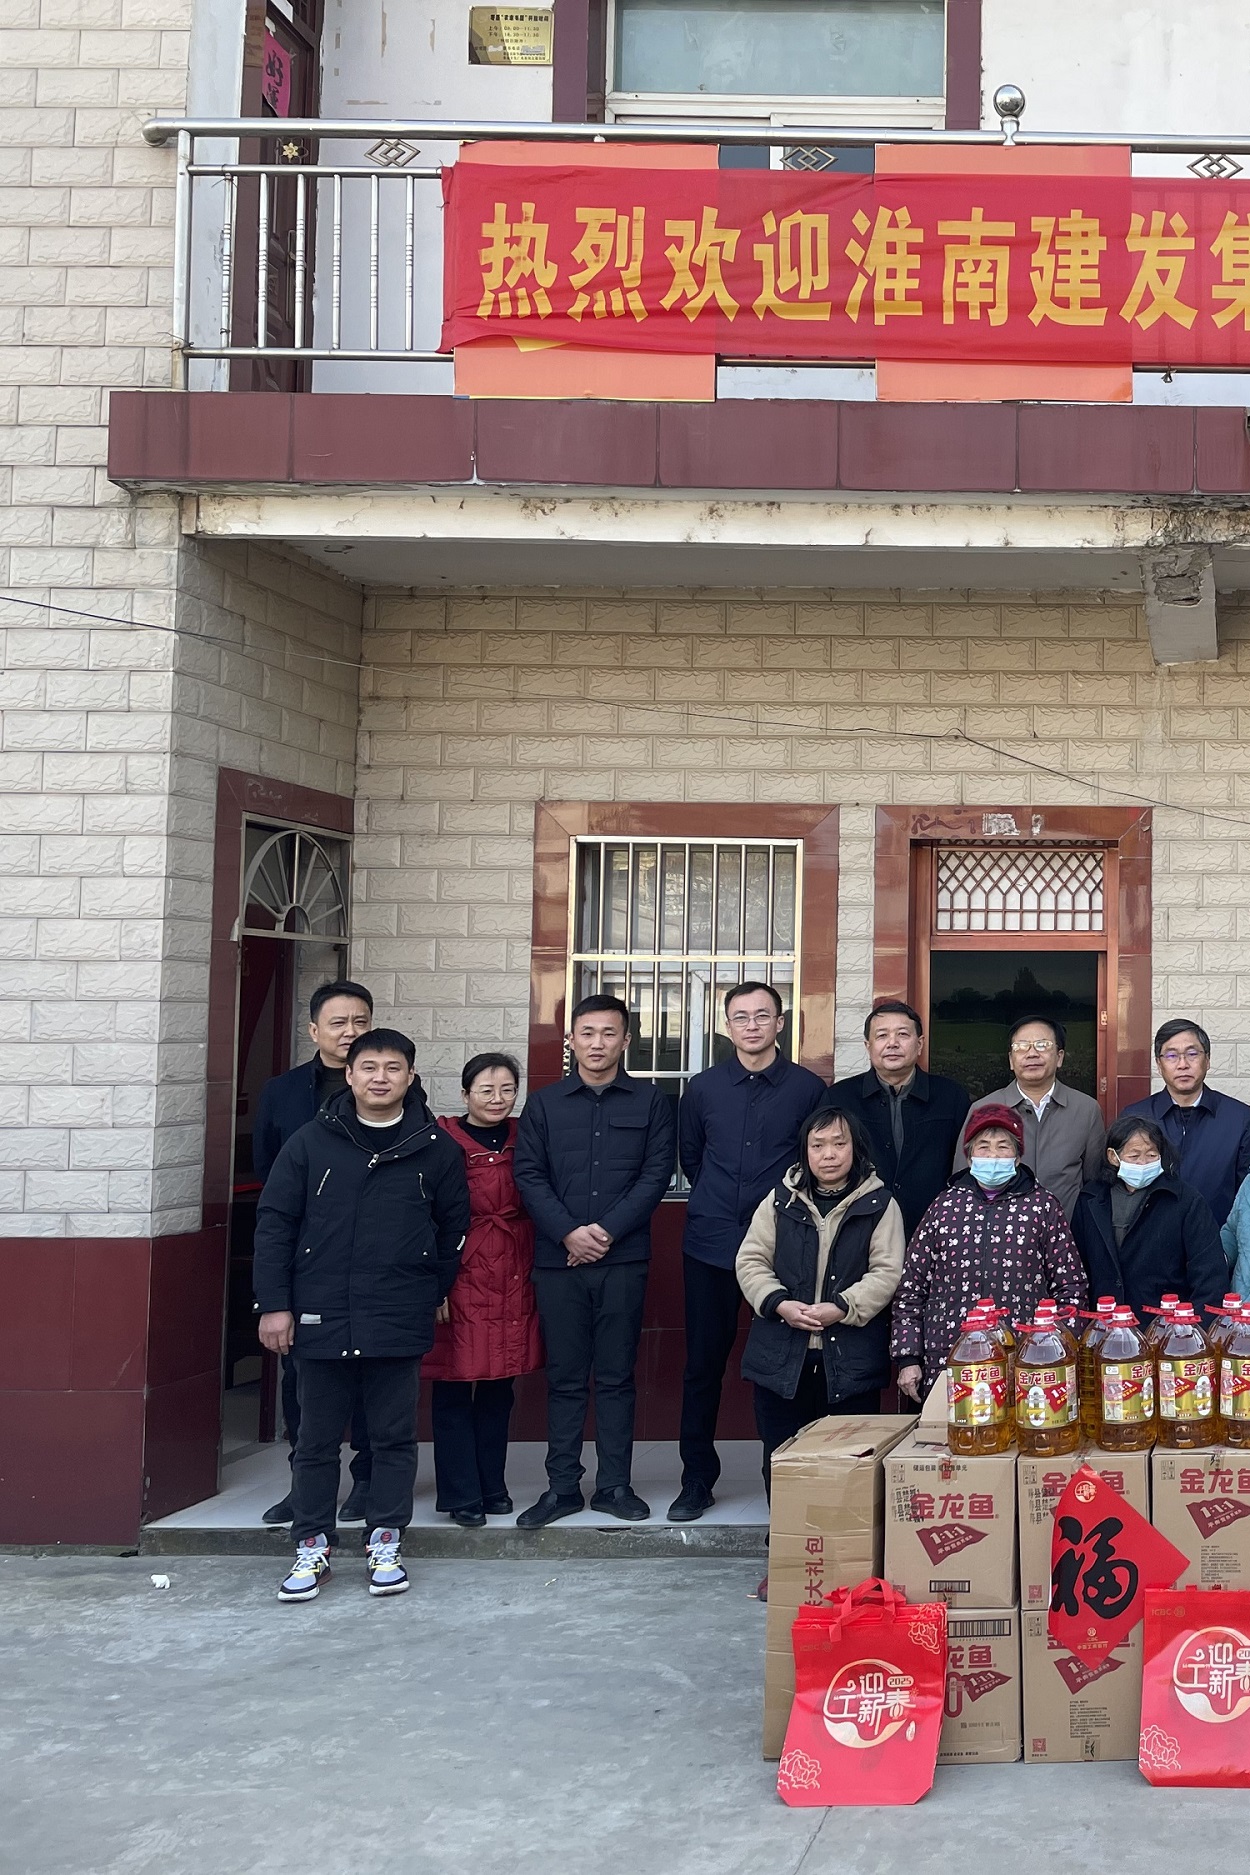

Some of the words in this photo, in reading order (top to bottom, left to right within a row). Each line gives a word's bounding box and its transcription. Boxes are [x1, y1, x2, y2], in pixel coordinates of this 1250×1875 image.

[961, 1366, 1001, 1382] 金龙鱼
[1019, 1371, 1057, 1386] 金龙鱼
[1042, 1470, 1125, 1497] 金鱼
[910, 1493, 994, 1519] 金龙鱼
[1200, 1500, 1235, 1518] 1:1:1
[930, 1526, 966, 1545] 1:1:1
[1052, 1515, 1139, 1619] 福
[888, 1677, 912, 1687] 2025
